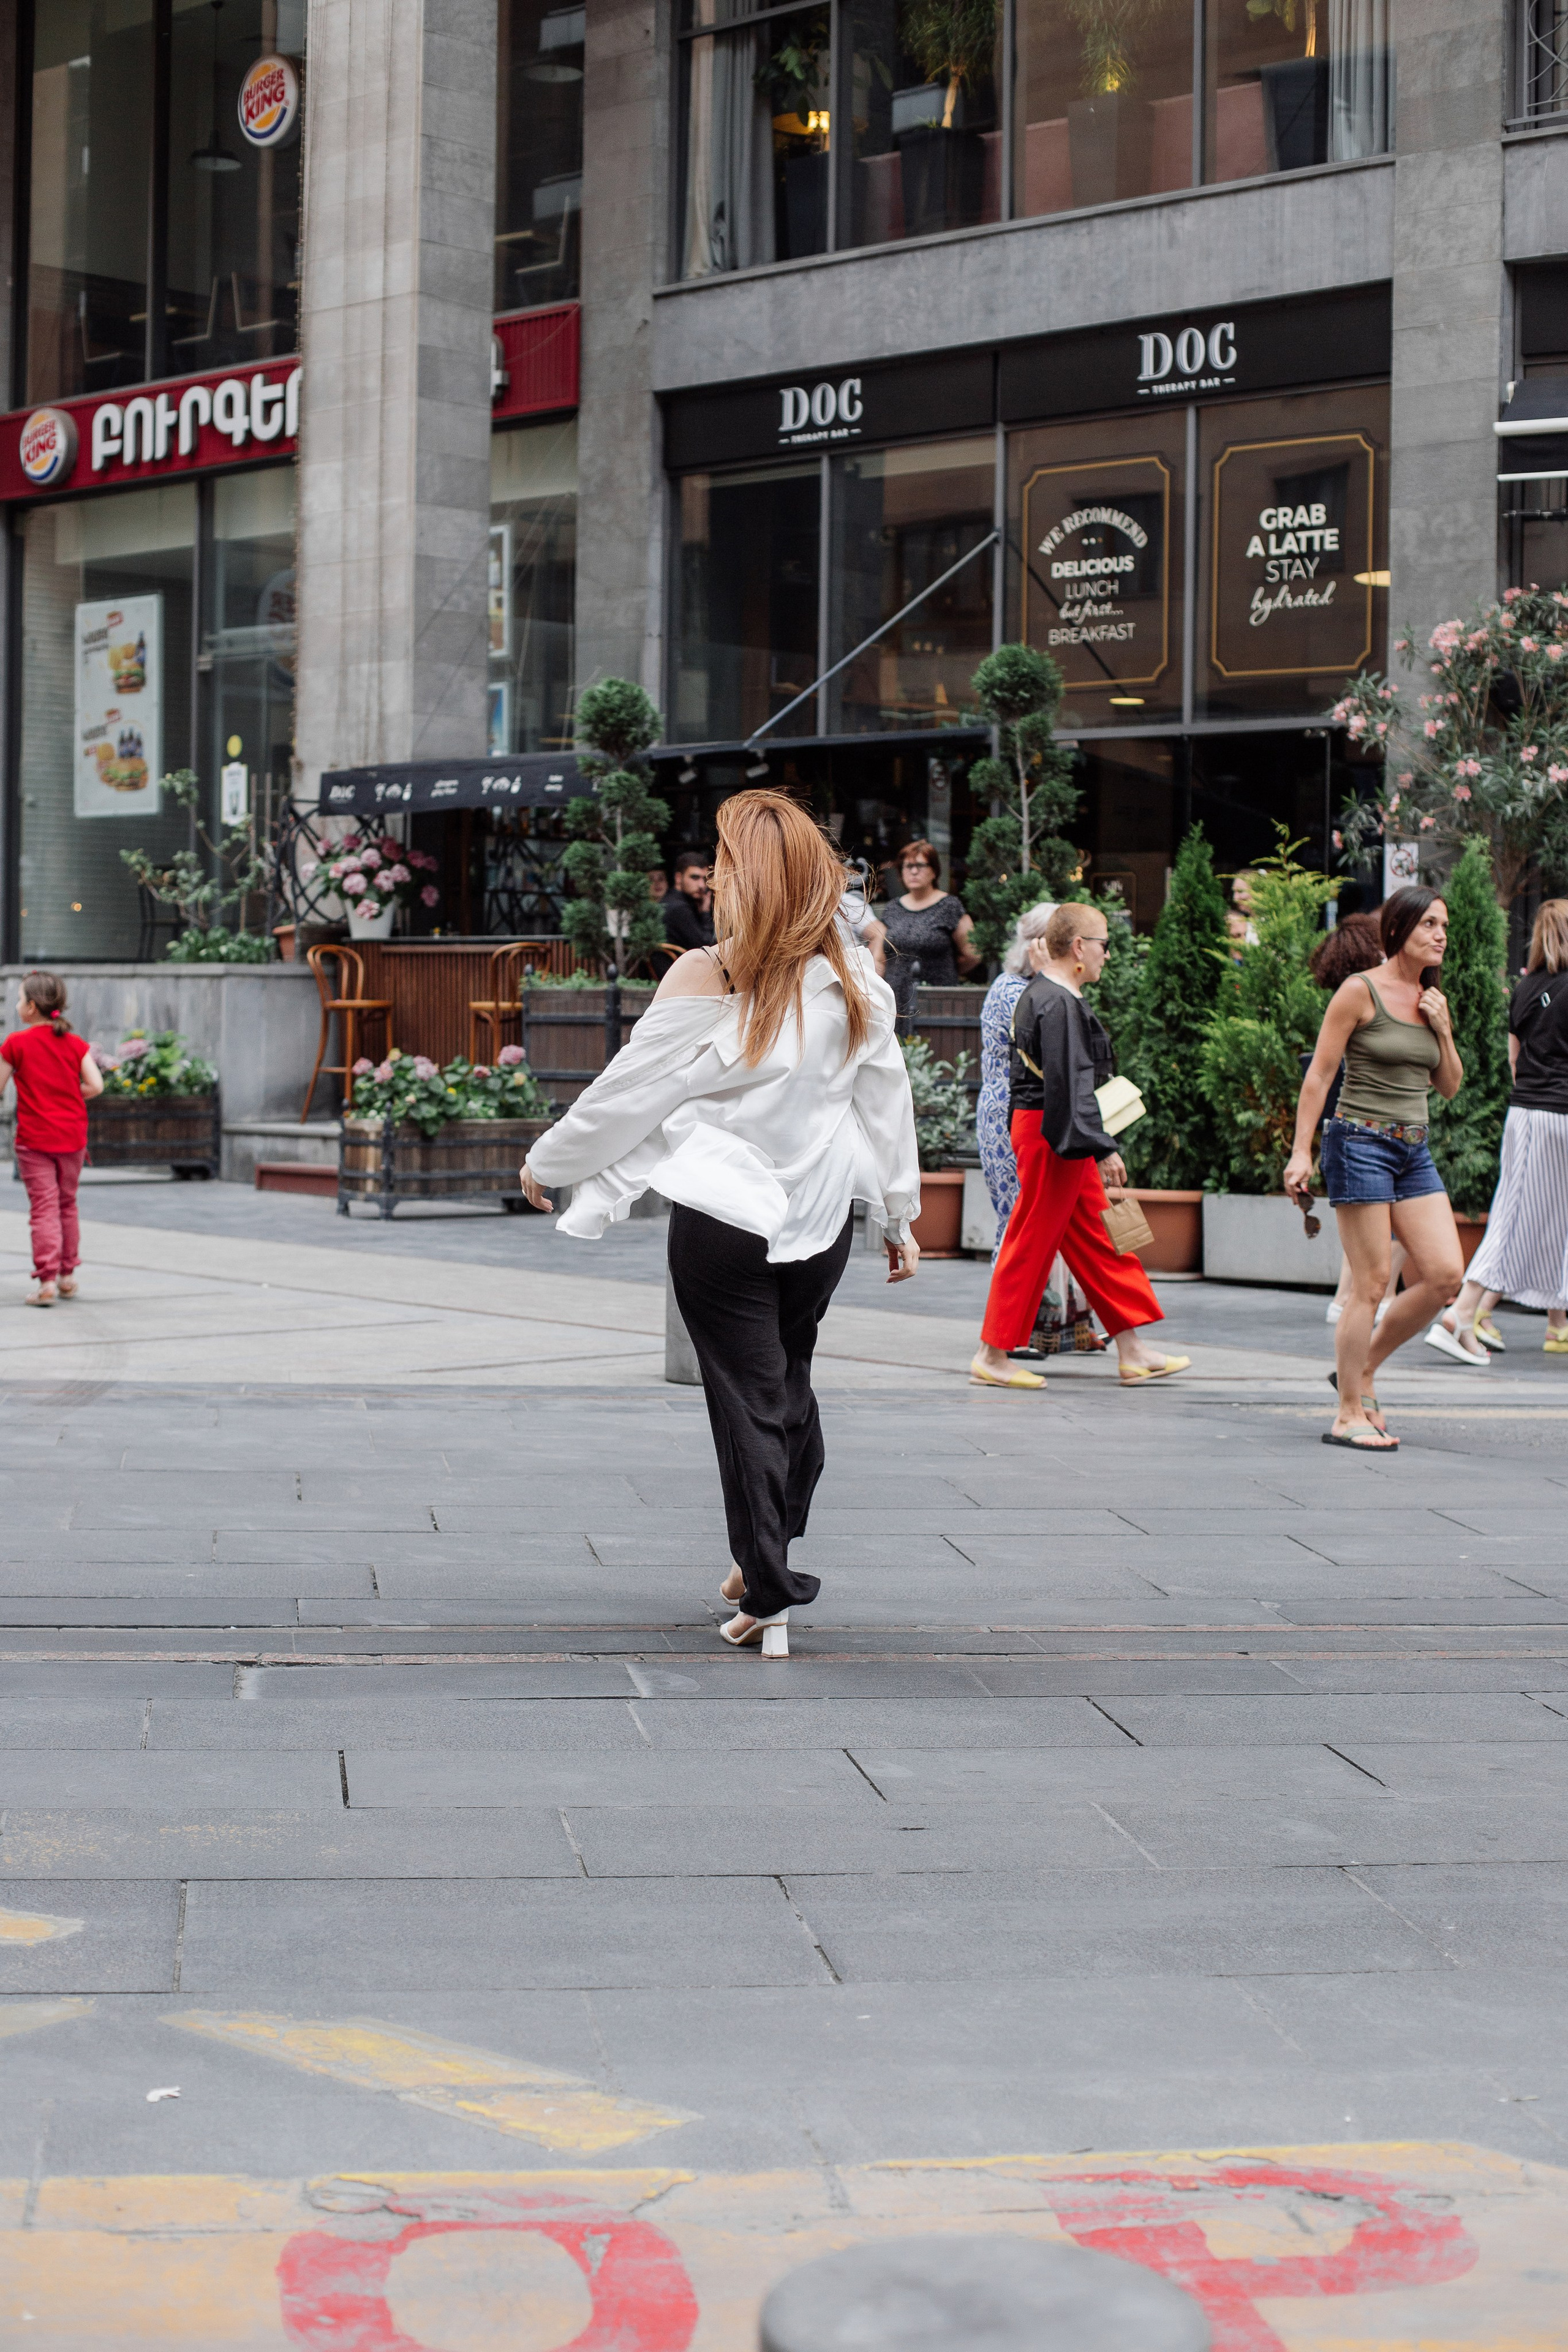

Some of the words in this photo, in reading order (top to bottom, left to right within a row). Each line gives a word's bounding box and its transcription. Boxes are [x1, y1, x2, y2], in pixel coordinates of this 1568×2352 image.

[244, 68, 284, 105] BURGER
[245, 81, 285, 126] KING
[1137, 322, 1237, 381] DOC
[1152, 380, 1197, 395] THERAPY
[1199, 377, 1221, 389] BAR
[778, 378, 863, 432] DOC
[1039, 526, 1066, 556] WE
[1061, 507, 1148, 548] RECOMMEND
[1259, 503, 1327, 531] GRAB
[1245, 535, 1266, 559] A
[1268, 527, 1340, 557] LATTE
[1051, 555, 1134, 579] DELICIOUS
[1265, 556, 1320, 582] STAY
[1065, 579, 1119, 600] LUNCH
[1249, 581, 1337, 627] hydrated
[1048, 622, 1137, 646] BREAKFAST
